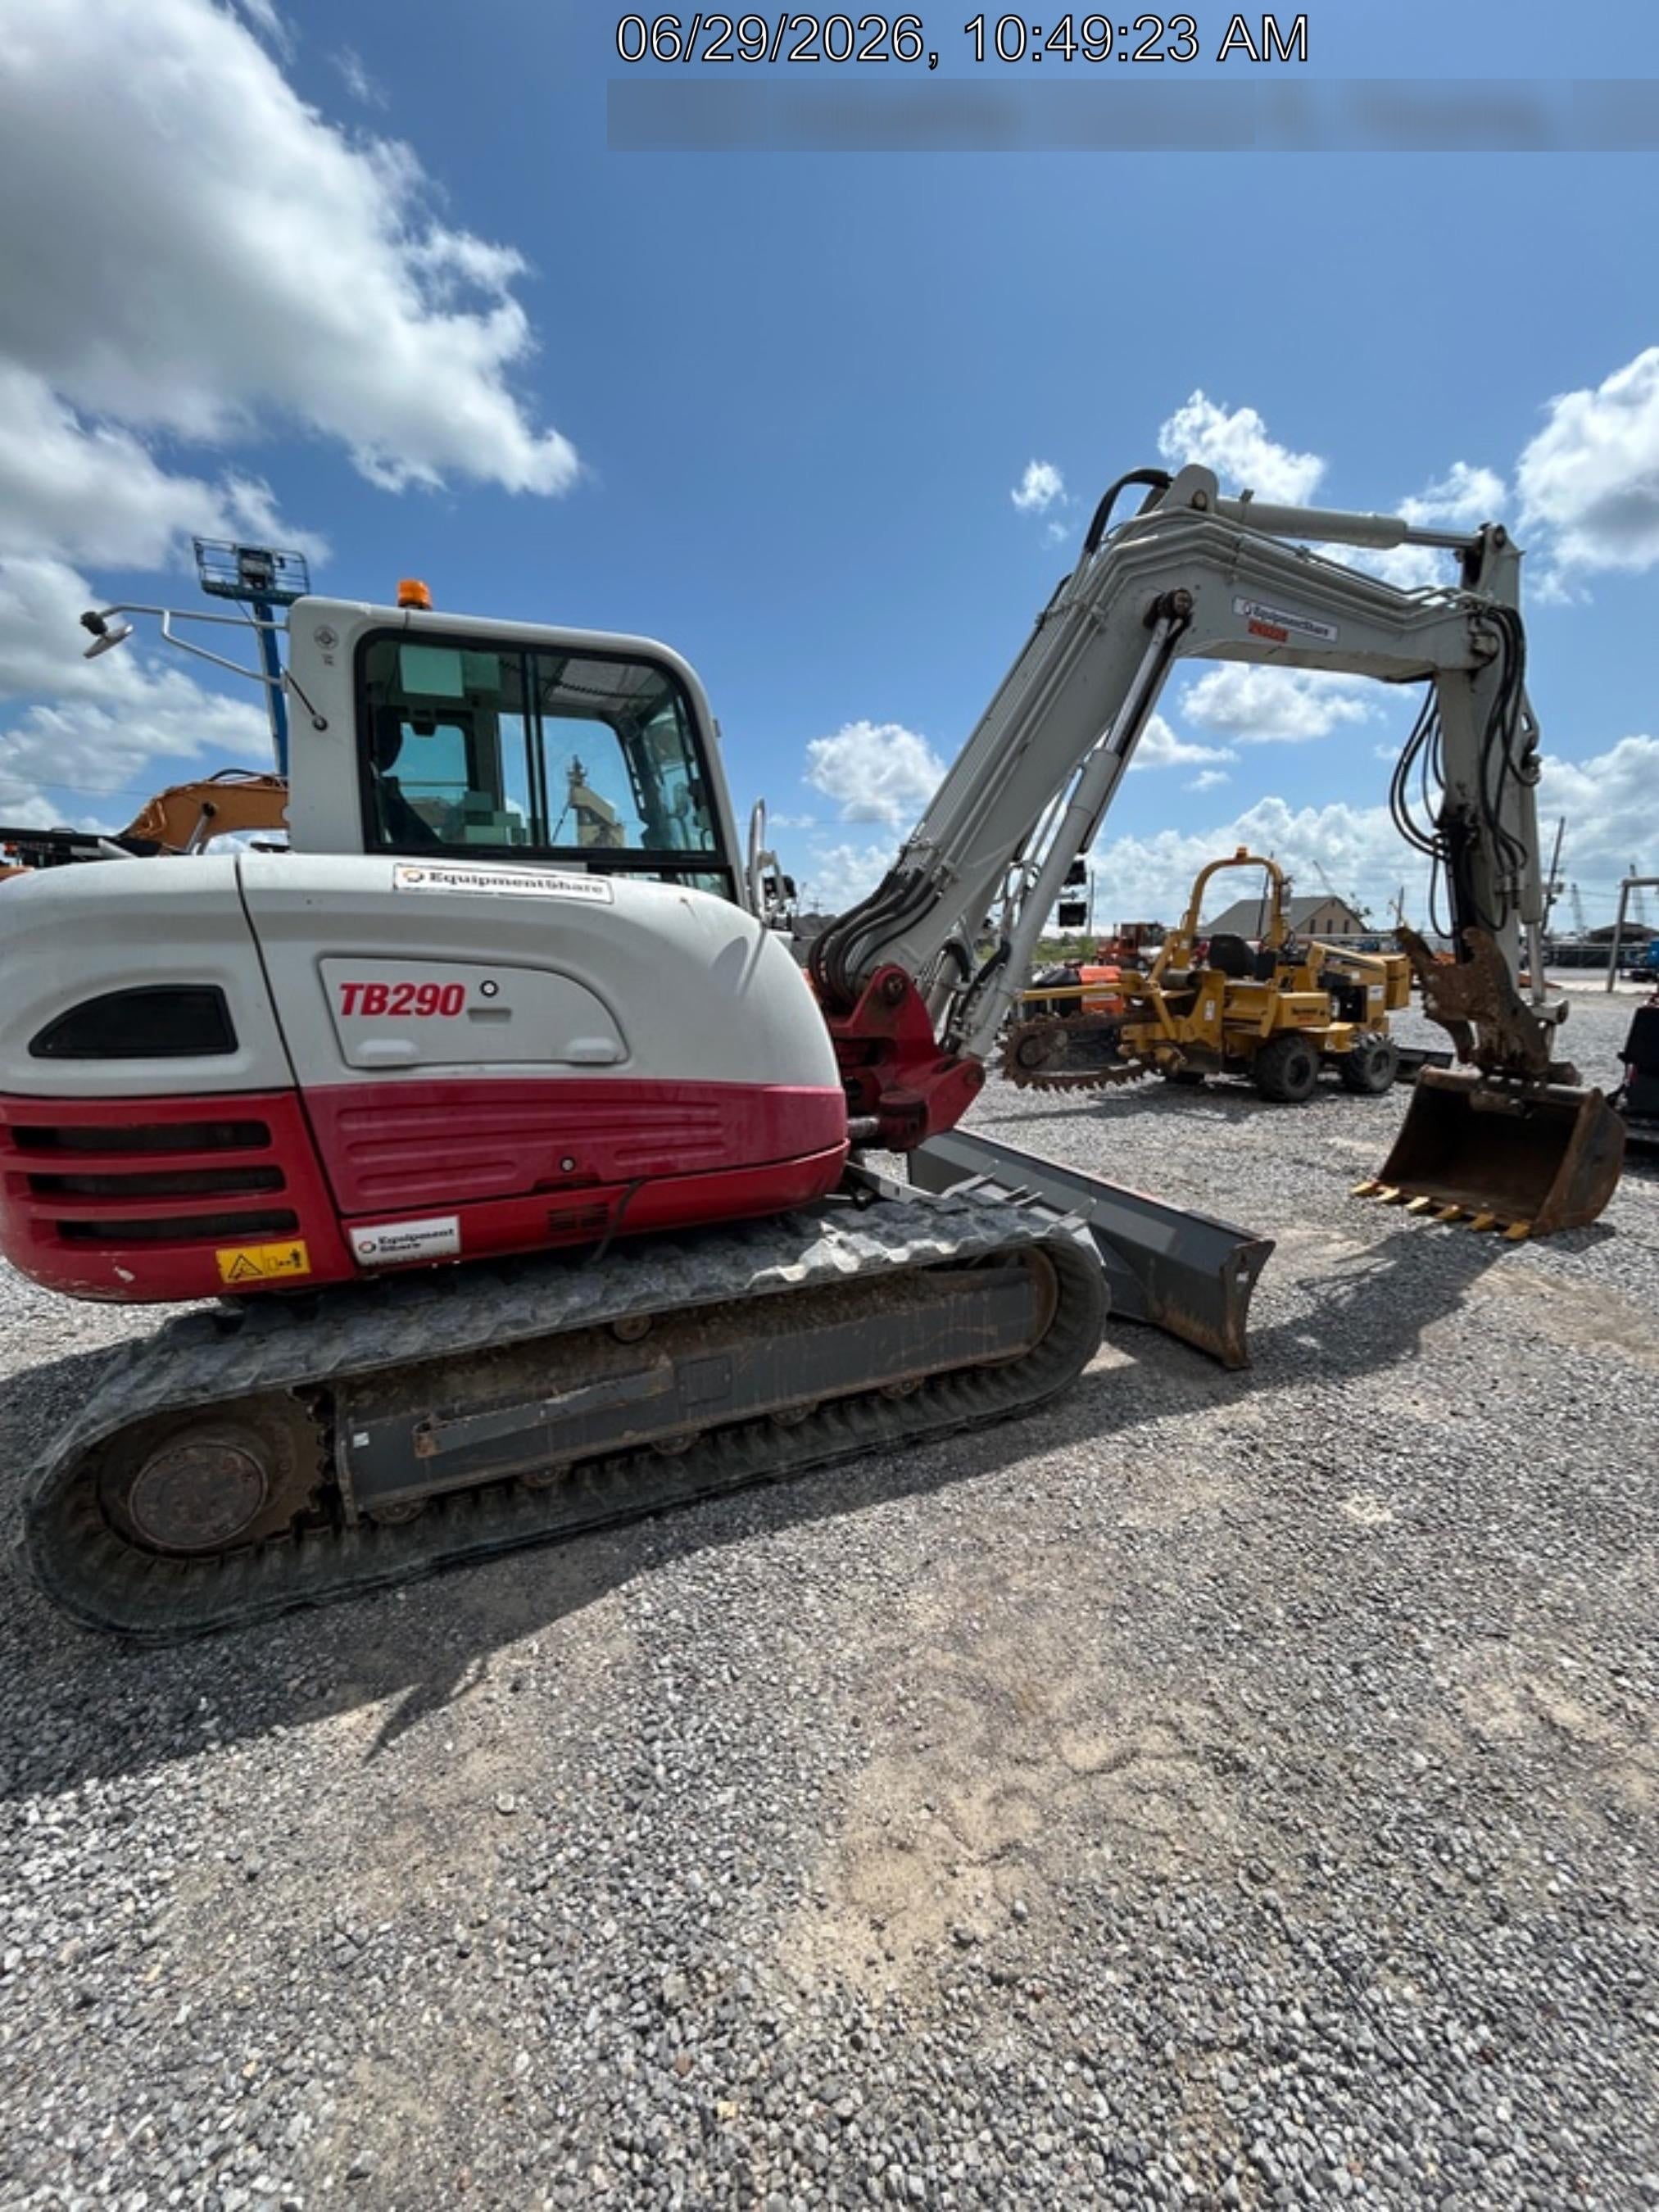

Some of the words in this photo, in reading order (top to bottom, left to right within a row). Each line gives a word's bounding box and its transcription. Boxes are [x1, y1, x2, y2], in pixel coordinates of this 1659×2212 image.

[428, 871, 603, 894] EquipmentShare
[339, 981, 466, 1017] TB290
[378, 1228, 455, 1244] Equipment
